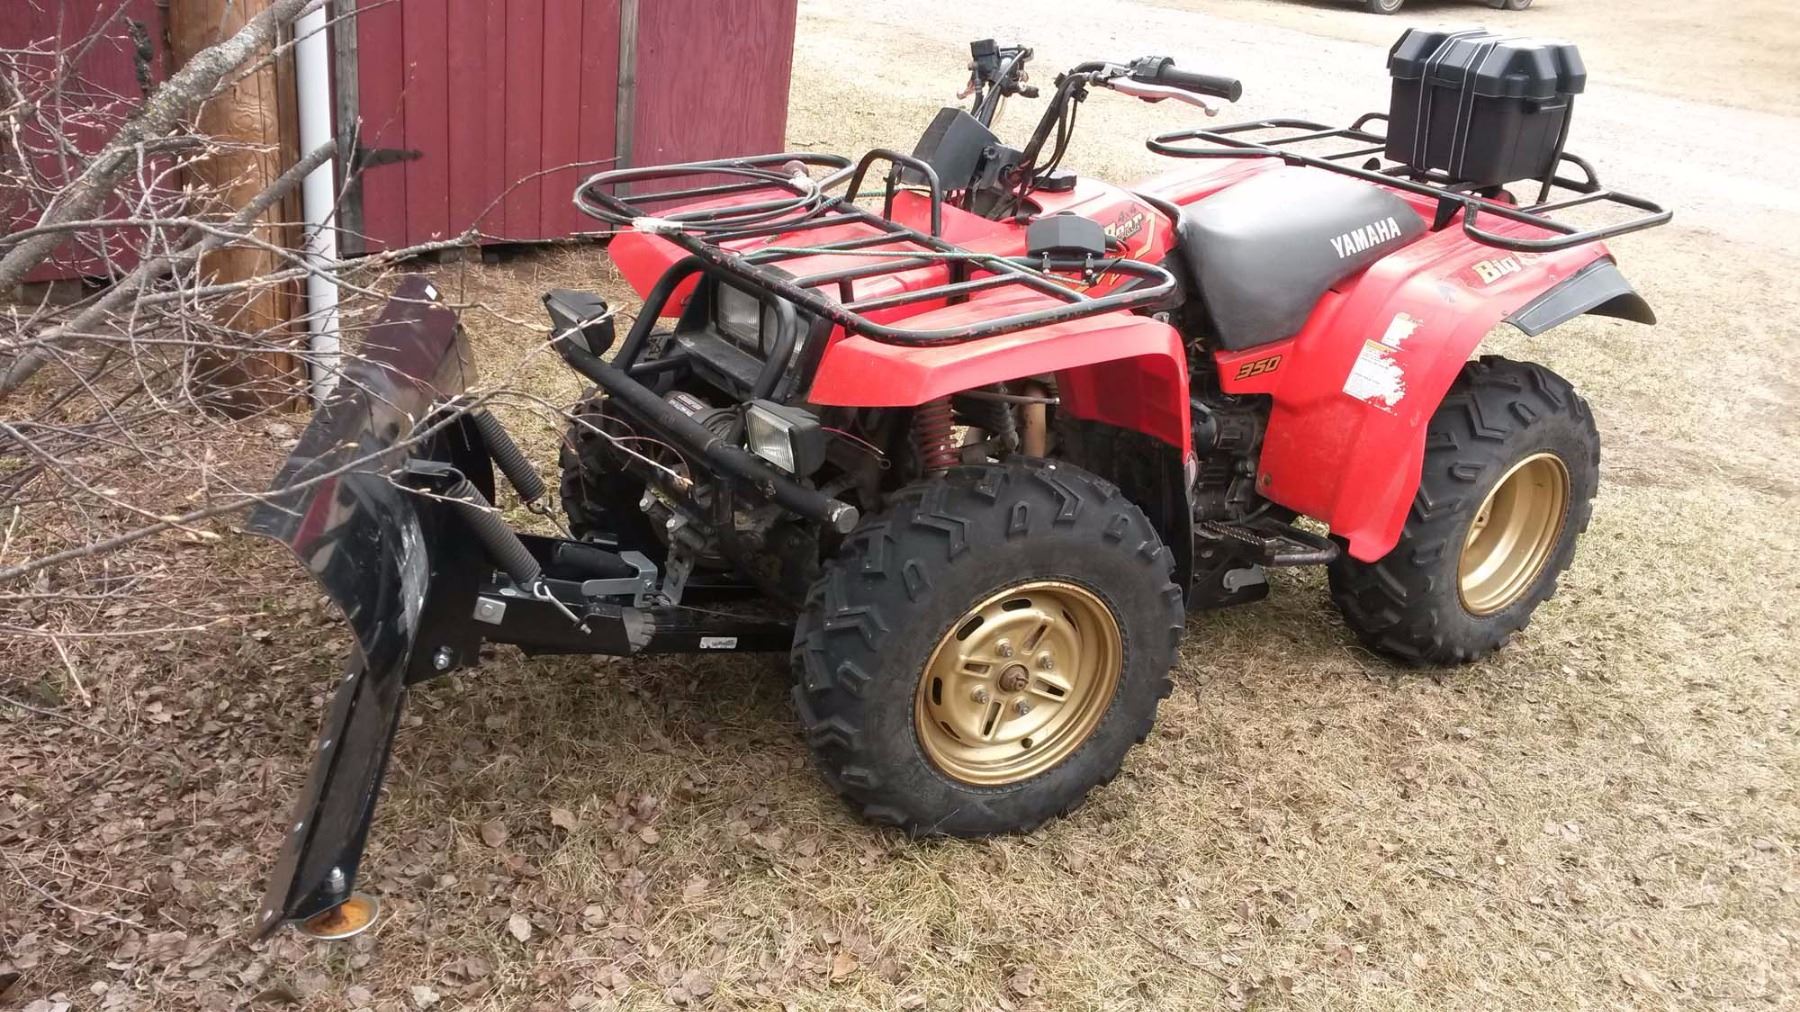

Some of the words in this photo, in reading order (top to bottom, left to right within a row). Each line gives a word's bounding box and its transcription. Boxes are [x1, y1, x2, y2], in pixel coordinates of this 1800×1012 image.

[1330, 217, 1401, 258] YAMAHA
[1471, 256, 1522, 284] Big
[1234, 355, 1283, 380] 350
